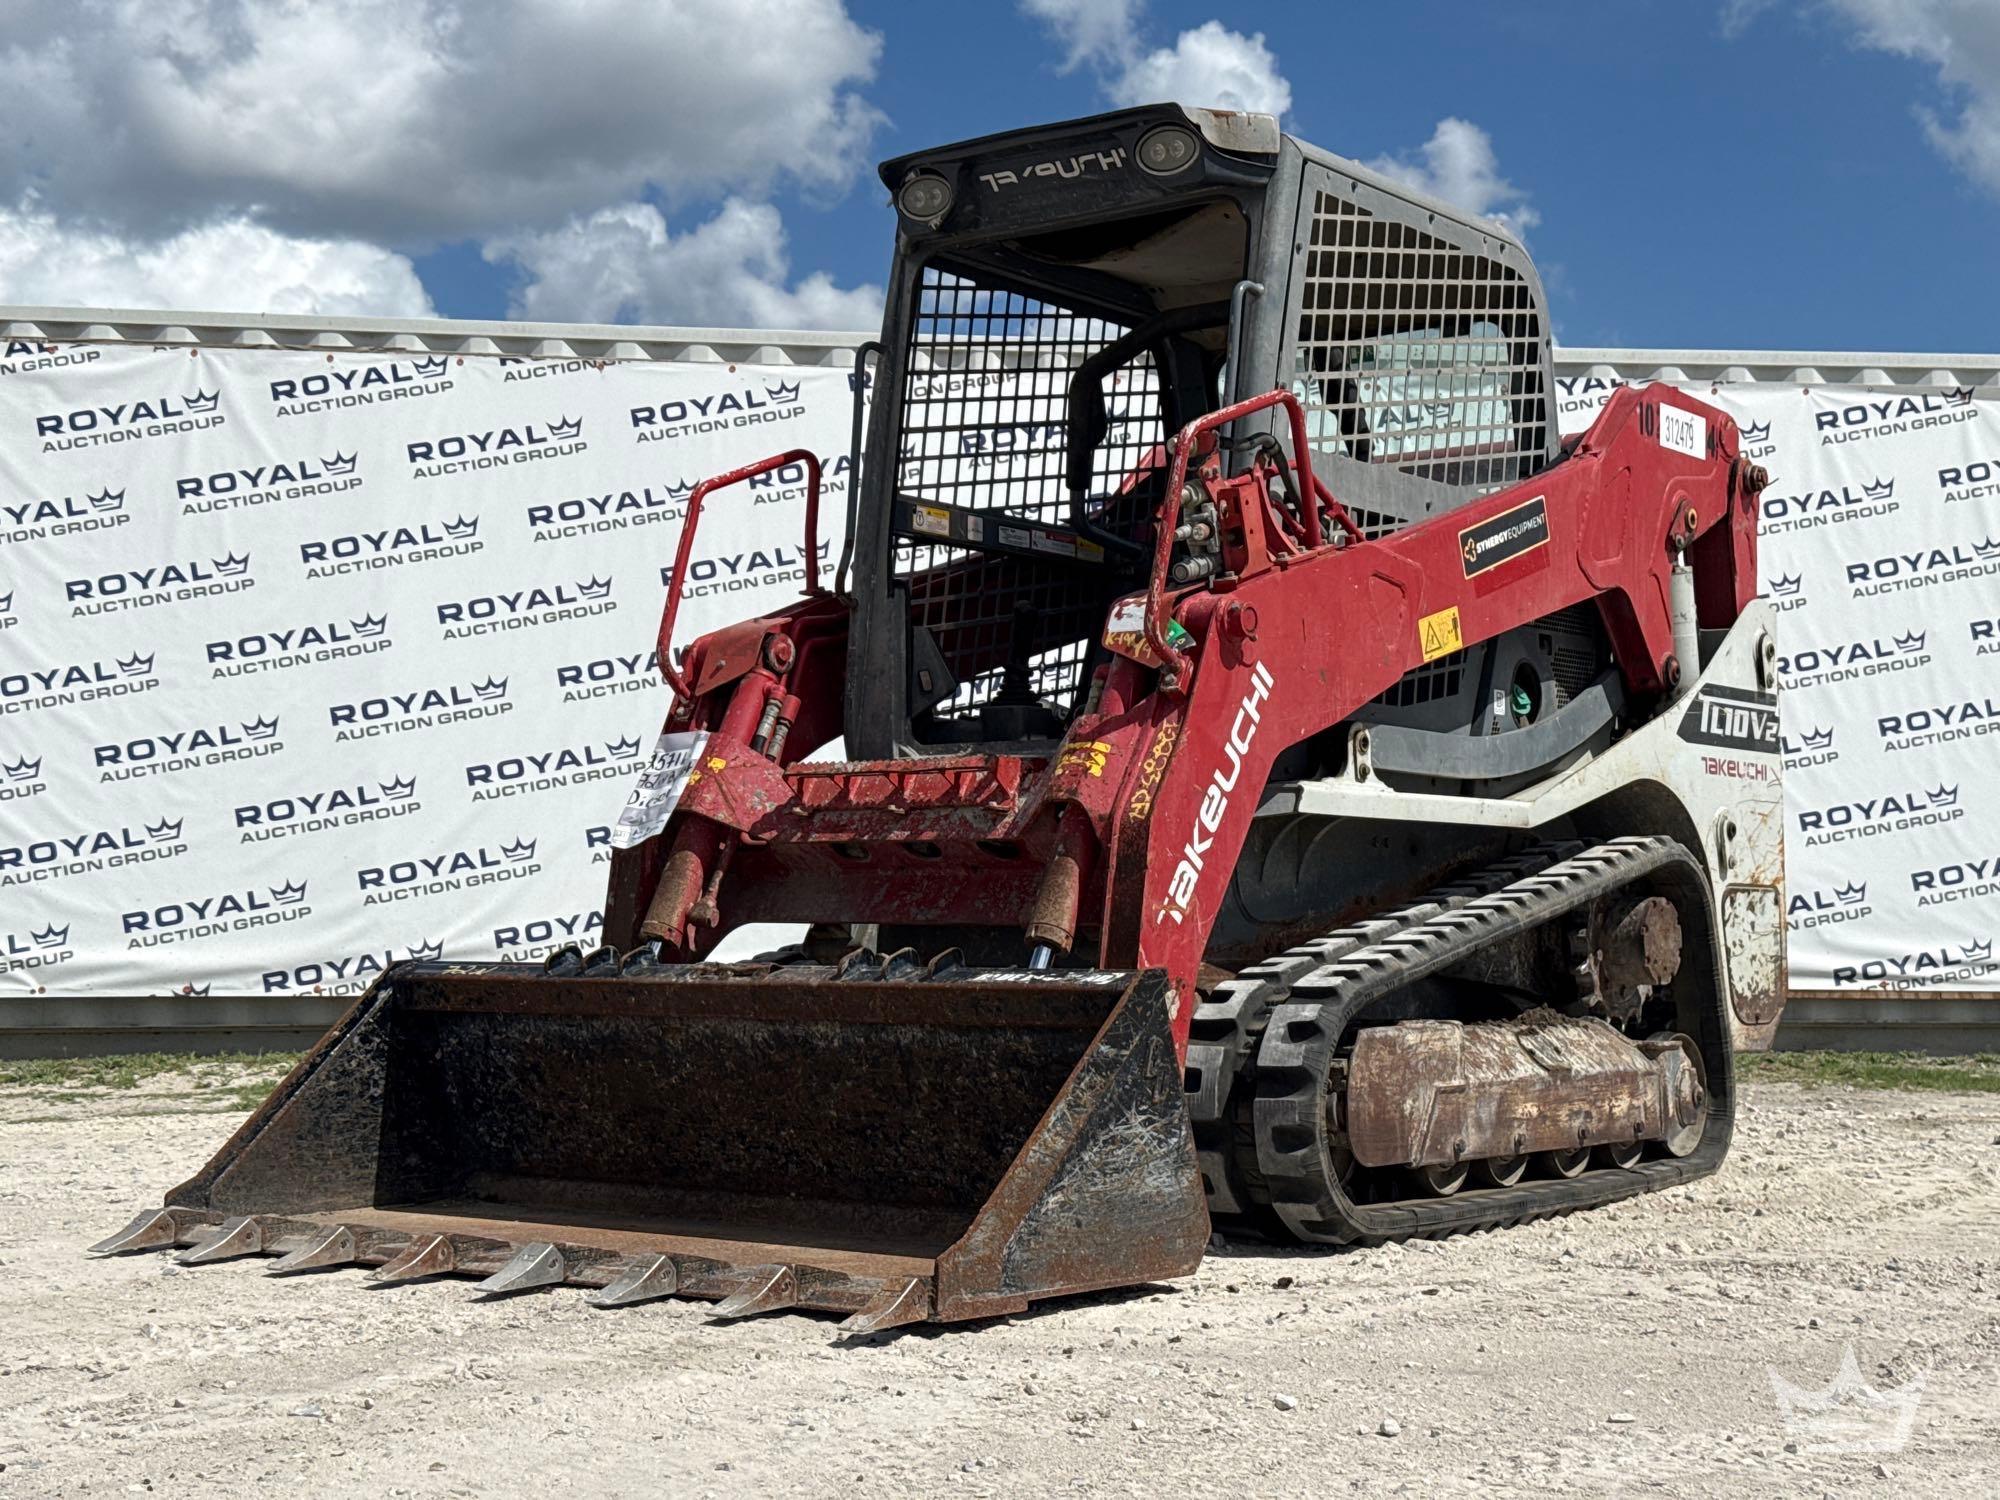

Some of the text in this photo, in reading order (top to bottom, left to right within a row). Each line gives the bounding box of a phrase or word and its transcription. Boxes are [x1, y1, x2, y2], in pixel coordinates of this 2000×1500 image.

[22, 351, 101, 372] GROUP
[270, 364, 413, 401] ROYAL
[277, 381, 453, 417] AUCTION GROUP
[36, 398, 183, 437] ROYAL
[630, 390, 766, 428] ROYAL
[637, 406, 805, 443] AUCTION GROUP
[1815, 394, 1941, 431] ROYAL
[43, 416, 225, 453] AUCTION GROUP
[407, 426, 548, 463] ROYAL
[1665, 415, 1694, 450] 312479
[1822, 410, 1978, 446] AUCTION GROUP
[414, 442, 587, 479] AUCTION GROUP
[176, 461, 322, 499] ROYAL
[183, 478, 362, 515] AUCTION GROUP
[754, 481, 844, 505] AUCTON
[0, 498, 88, 525] YAL
[528, 488, 666, 526] ROYAL
[1757, 502, 1900, 536] UCTION GROUP
[1763, 487, 1862, 519] OYAL
[51, 514, 130, 536] GROUP
[534, 518, 627, 542] AUCTION
[300, 525, 443, 564] ROYAL
[306, 542, 483, 579] AUCTION GROUP
[65, 562, 213, 602] ROYAL
[1846, 546, 1973, 583] ROYAL
[1853, 563, 2000, 598] AUCTION GROU
[72, 579, 254, 618] AUCTION GROUP
[437, 586, 577, 624] ROYAL
[680, 577, 758, 600] UCTION
[444, 602, 617, 640] AUCTION GROUP
[206, 623, 351, 663] ROYAL
[212, 640, 392, 679] AUCTION GROUP
[1776, 640, 1894, 674] ROYAL
[0, 662, 117, 697] OYAL
[1863, 655, 1930, 676] GROUP
[80, 679, 159, 701] GROUP
[330, 686, 472, 726] ROYAL
[563, 677, 656, 702] AUCTION
[336, 702, 512, 742] AUCTION GROUP
[1878, 699, 2000, 737] ROYAL
[94, 726, 242, 767] ROYAL
[1885, 727, 1970, 752] AUCTION
[100, 742, 283, 783] AUCTION GROUP
[466, 746, 606, 786] ROYAL
[1784, 751, 1839, 770] ROUP
[0, 783, 46, 801] OUP
[472, 776, 567, 802] AUCTION
[572, 762, 646, 784] GROUP
[234, 786, 380, 828] ROYAL
[241, 802, 420, 844] AUCTION GROUP
[1798, 794, 1927, 832] ROYAL
[1806, 809, 1963, 846] AUCTION GROUP
[0, 828, 146, 870] ROYAL
[1, 844, 188, 886] AUCTION GROUP
[358, 848, 501, 890] ROYAL
[364, 864, 541, 906] AUCTION GROUP
[122, 891, 270, 934] ROYAL
[128, 907, 311, 950] AUCTION GROUP
[494, 911, 604, 949] ROYA
[1803, 906, 1872, 929] GROUP
[1833, 948, 1961, 987] ROYAL
[1930, 963, 1998, 985] GROUP
